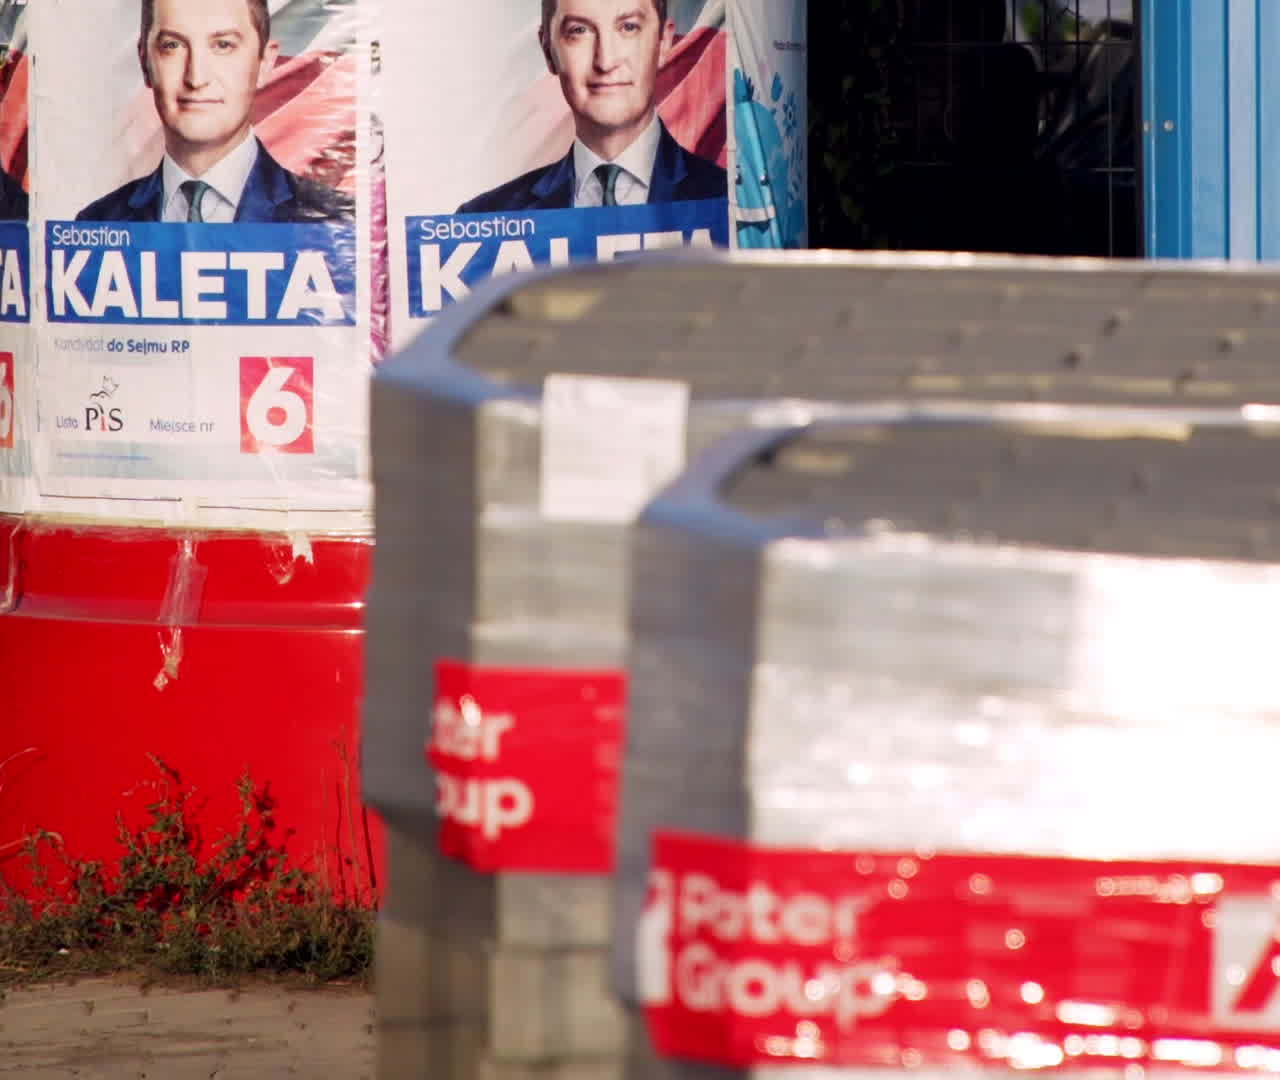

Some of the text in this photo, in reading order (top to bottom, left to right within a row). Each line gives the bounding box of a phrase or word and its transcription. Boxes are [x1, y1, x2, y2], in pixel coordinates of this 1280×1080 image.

[52, 225, 130, 246] Sebastian
[420, 217, 535, 240] Sebastian
[51, 251, 345, 319] KALETA
[107, 339, 123, 352] do
[127, 339, 167, 355] Sejmu
[171, 340, 189, 353] RP
[246, 367, 307, 446] 6
[85, 407, 124, 432] PiS
[150, 419, 215, 434] Miejsce nr
[677, 941, 898, 1033] Group
